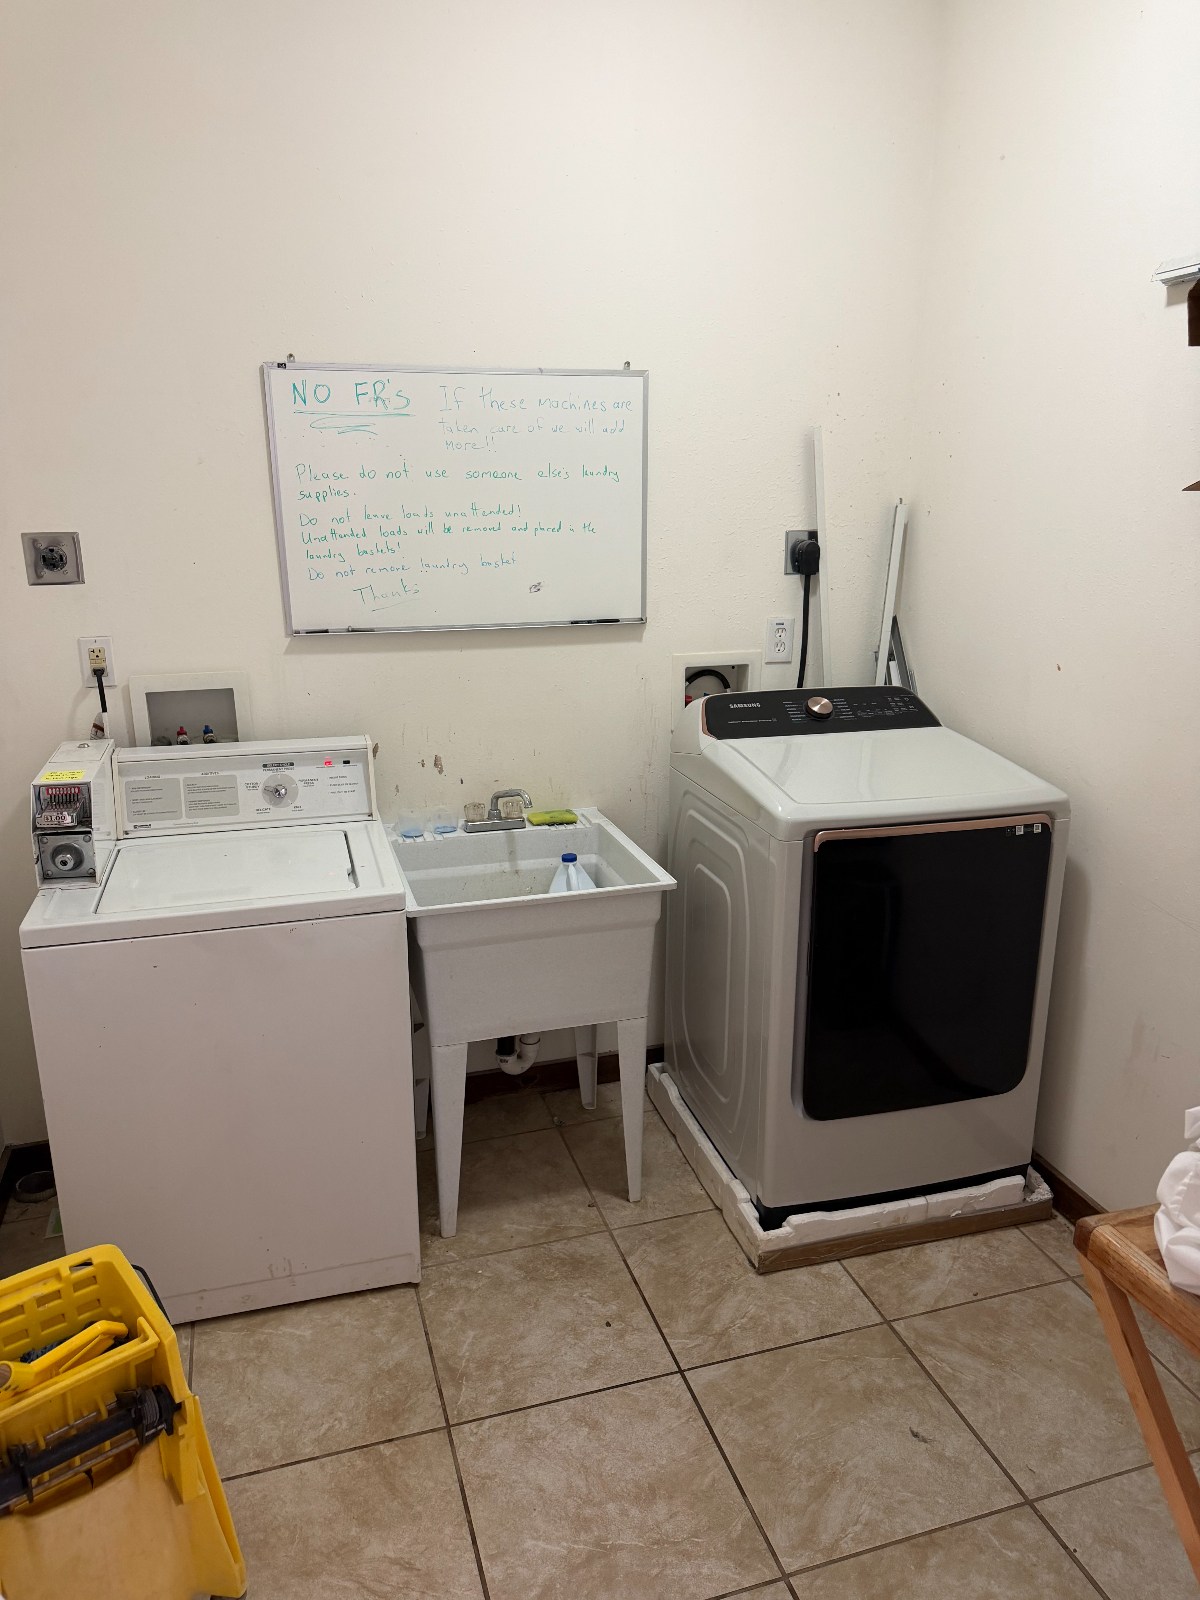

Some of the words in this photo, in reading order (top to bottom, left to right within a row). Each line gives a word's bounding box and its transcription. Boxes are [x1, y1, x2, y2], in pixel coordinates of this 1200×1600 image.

[292, 379, 331, 406] NO
[355, 379, 411, 410] FR's
[439, 385, 465, 411] If
[479, 386, 527, 411] these
[613, 399, 632, 411] are
[438, 417, 479, 435] taken
[490, 424, 520, 434] care
[527, 416, 545, 433] of
[551, 424, 569, 433] we
[575, 418, 594, 434] will
[602, 419, 625, 434] add
[295, 463, 349, 484] Please
[359, 464, 377, 479] do
[386, 461, 409, 479] not
[425, 469, 449, 478] use
[465, 470, 522, 480] someone
[582, 464, 619, 482] laundry
[297, 485, 356, 502] supplies.
[299, 512, 318, 527] Do
[331, 507, 350, 525] not
[364, 504, 393, 520] leave
[401, 504, 434, 519] loads
[445, 502, 521, 517] unattended!
[301, 528, 367, 544] Unattended
[379, 525, 408, 538] loads
[417, 521, 434, 535] will
[443, 522, 453, 533] be
[462, 521, 501, 532] removed
[511, 521, 528, 532] and
[534, 520, 562, 536] placed
[582, 521, 596, 533] the
[306, 549, 346, 562] laundry
[307, 567, 324, 580] Do
[335, 564, 356, 578] not
[365, 565, 411, 574] remove
[420, 557, 469, 575] laundry
[479, 551, 516, 568] basket
[352, 578, 420, 605] Thanks
